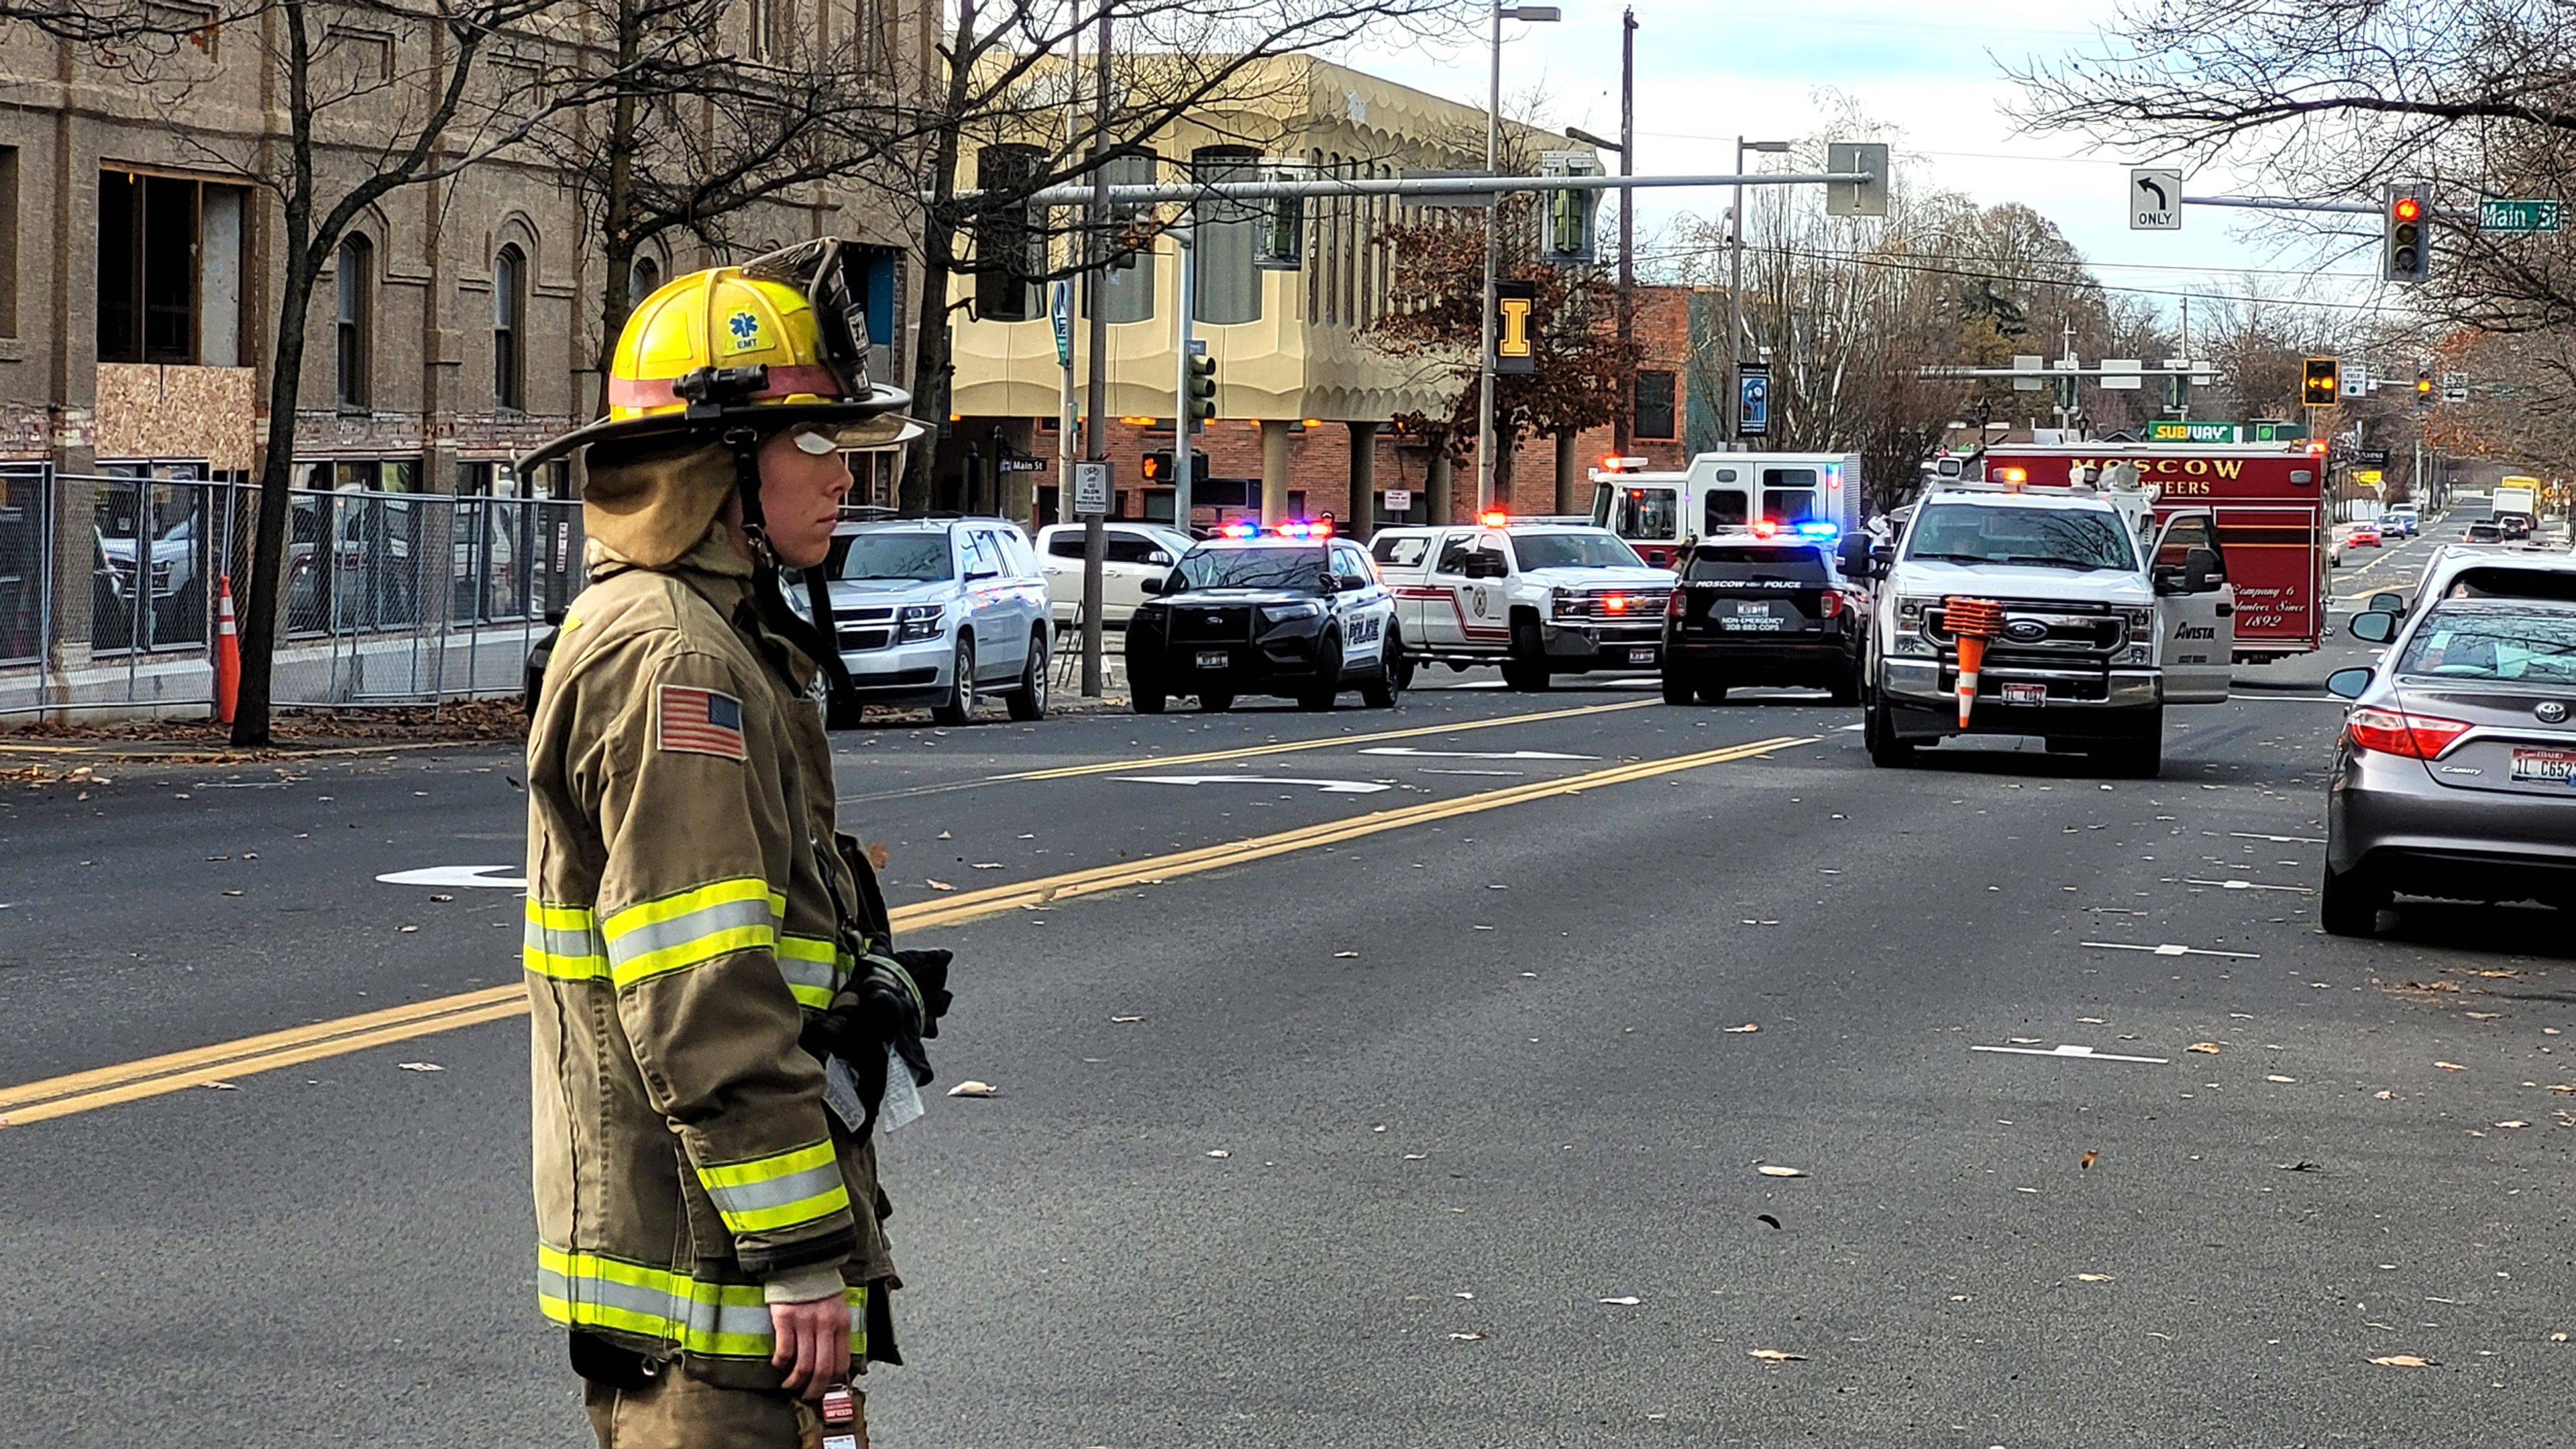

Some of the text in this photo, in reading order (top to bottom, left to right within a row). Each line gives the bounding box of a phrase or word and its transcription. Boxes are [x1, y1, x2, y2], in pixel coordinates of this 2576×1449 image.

[2139, 213, 2173, 225] ONLY
[2480, 204, 2526, 227] Main
[1500, 298, 1531, 356] I
[737, 337, 757, 349] EMT
[2154, 425, 2228, 439] SUBWAY
[1013, 460, 1042, 470] Main St
[2232, 584, 2294, 598] Company 6
[2275, 600, 2306, 612] Since
[2245, 615, 2282, 627] 1892
[1347, 617, 1379, 646] POLICE
[2516, 759, 2530, 775] 1L
